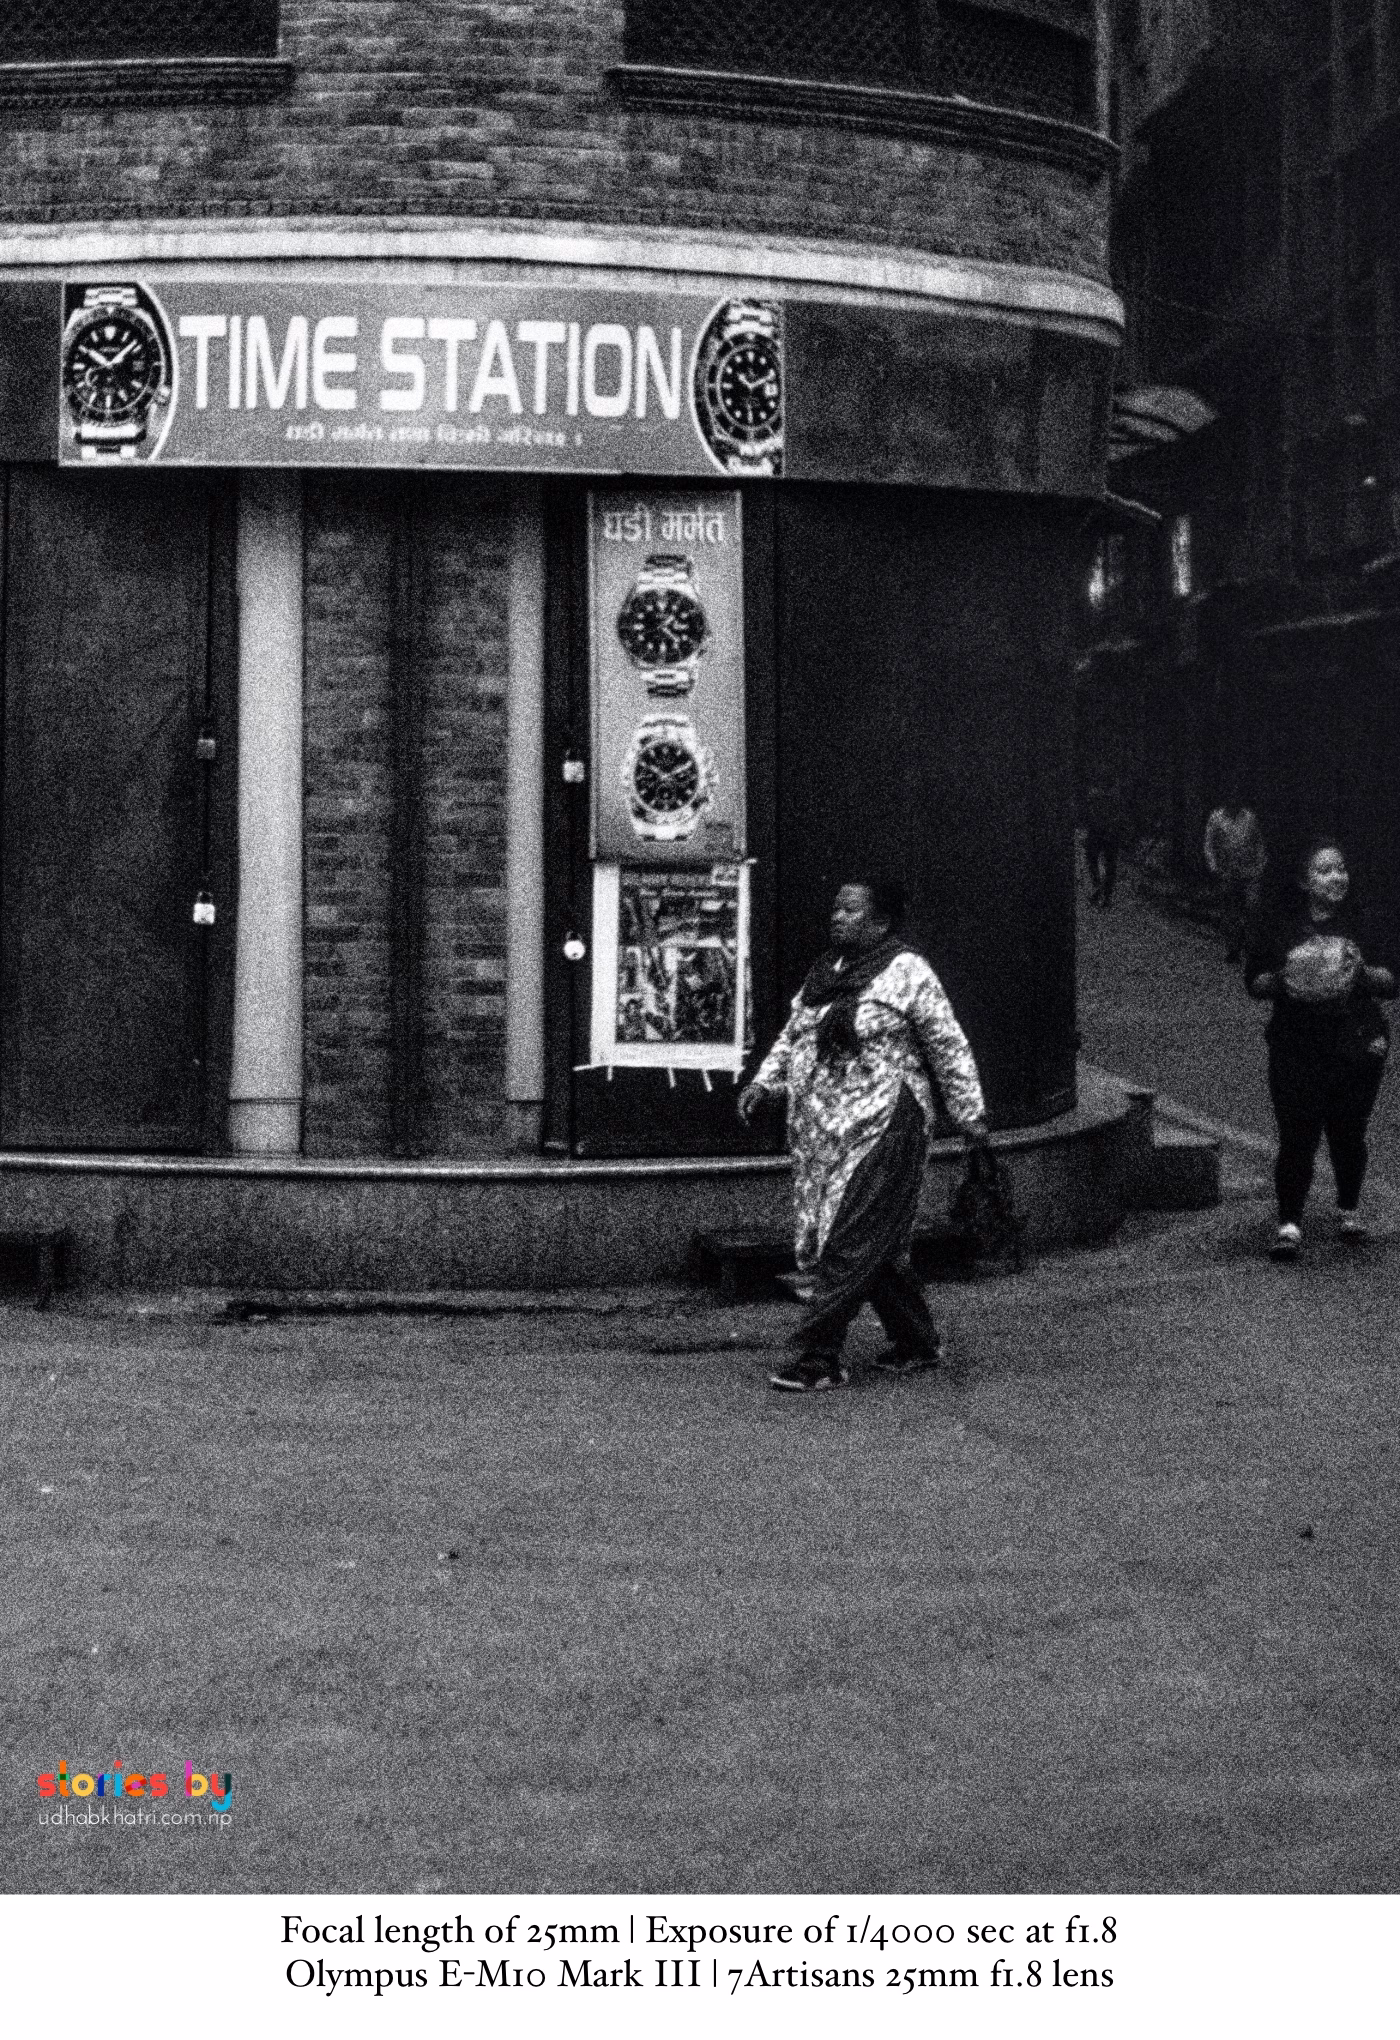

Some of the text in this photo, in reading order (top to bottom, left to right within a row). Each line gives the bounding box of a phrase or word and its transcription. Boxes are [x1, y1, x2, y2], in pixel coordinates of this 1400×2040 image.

[179, 315, 682, 419] TIME STATION
[660, 504, 727, 543] मर्मत
